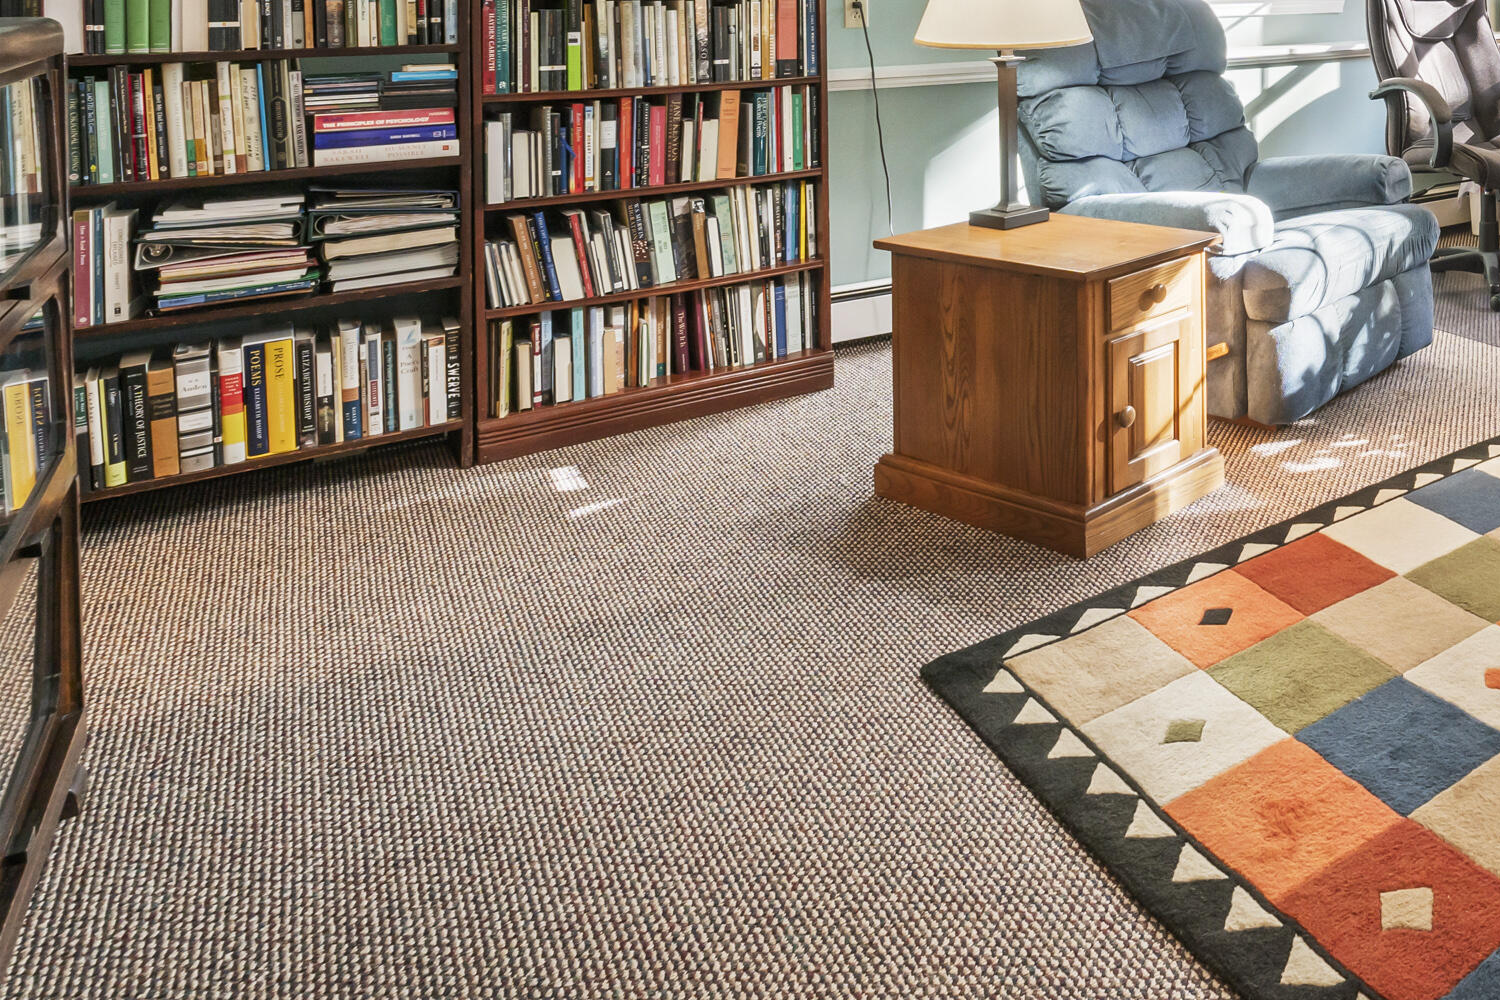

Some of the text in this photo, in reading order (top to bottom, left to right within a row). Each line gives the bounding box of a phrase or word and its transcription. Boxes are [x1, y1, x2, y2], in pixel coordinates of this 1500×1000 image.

[487, 13, 496, 71] HAYDEN CARRUTH
[69, 98, 81, 172] THE ORIGINAL CHING
[671, 100, 681, 162] JANE KENYON
[755, 120, 763, 138] Poems
[677, 311, 685, 323] The
[677, 322, 686, 335] Way
[273, 347, 286, 381] PROSE
[447, 362, 461, 399] SWERVE
[249, 349, 263, 440] POEMS ELIZABETH BISHOP
[301, 349, 313, 421] ELIZABETH BISHOP
[134, 390, 144, 419] THEORY
[135, 420, 145, 429] OF
[136, 430, 148, 459] JUSTICE
